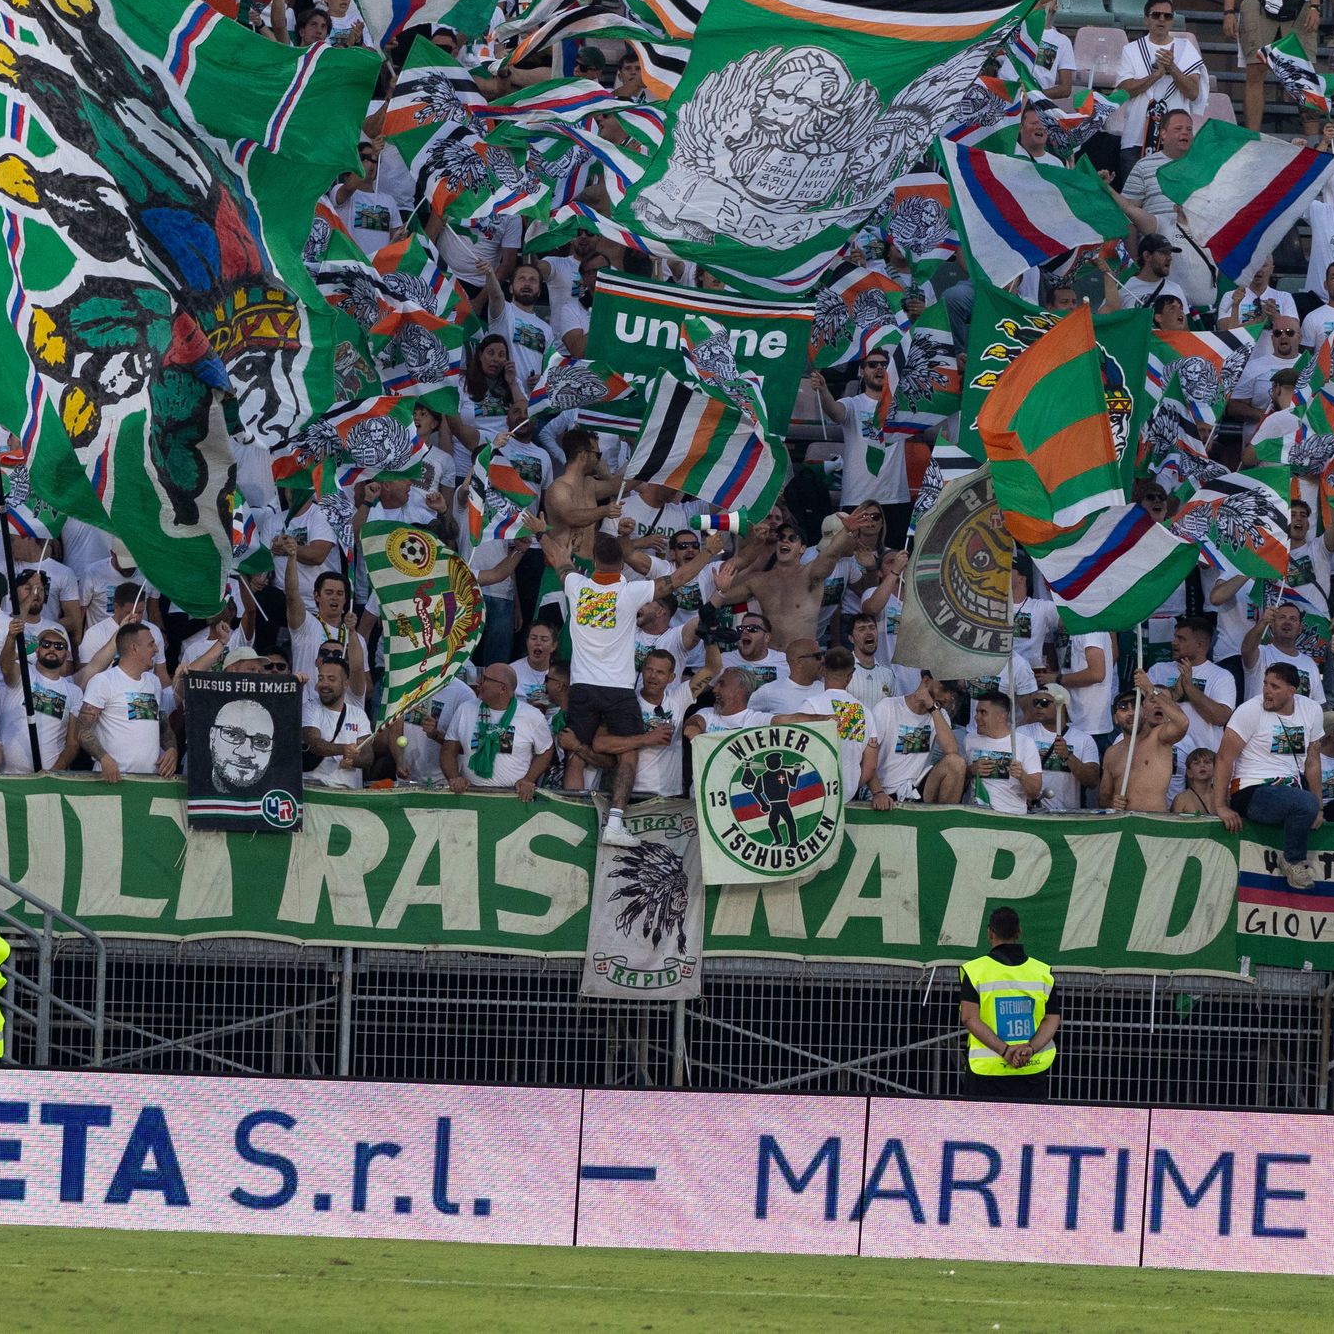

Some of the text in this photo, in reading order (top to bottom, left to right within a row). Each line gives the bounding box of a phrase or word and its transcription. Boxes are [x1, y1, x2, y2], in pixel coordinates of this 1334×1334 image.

[615, 310, 787, 359] unne
[187, 676, 298, 694] LUKSUS FÜR IMMER
[727, 727, 811, 759] WIENER
[709, 780, 839, 808] 13 12
[622, 811, 677, 831] TRAS
[721, 814, 835, 869] TSCHUSCHEN
[612, 969, 679, 988] RAPID
[999, 999, 1033, 1016] STEWARD
[1006, 1018, 1033, 1038] 168
[231, 1107, 492, 1216] S.r.l.
[755, 1134, 1310, 1238] MARITIME
